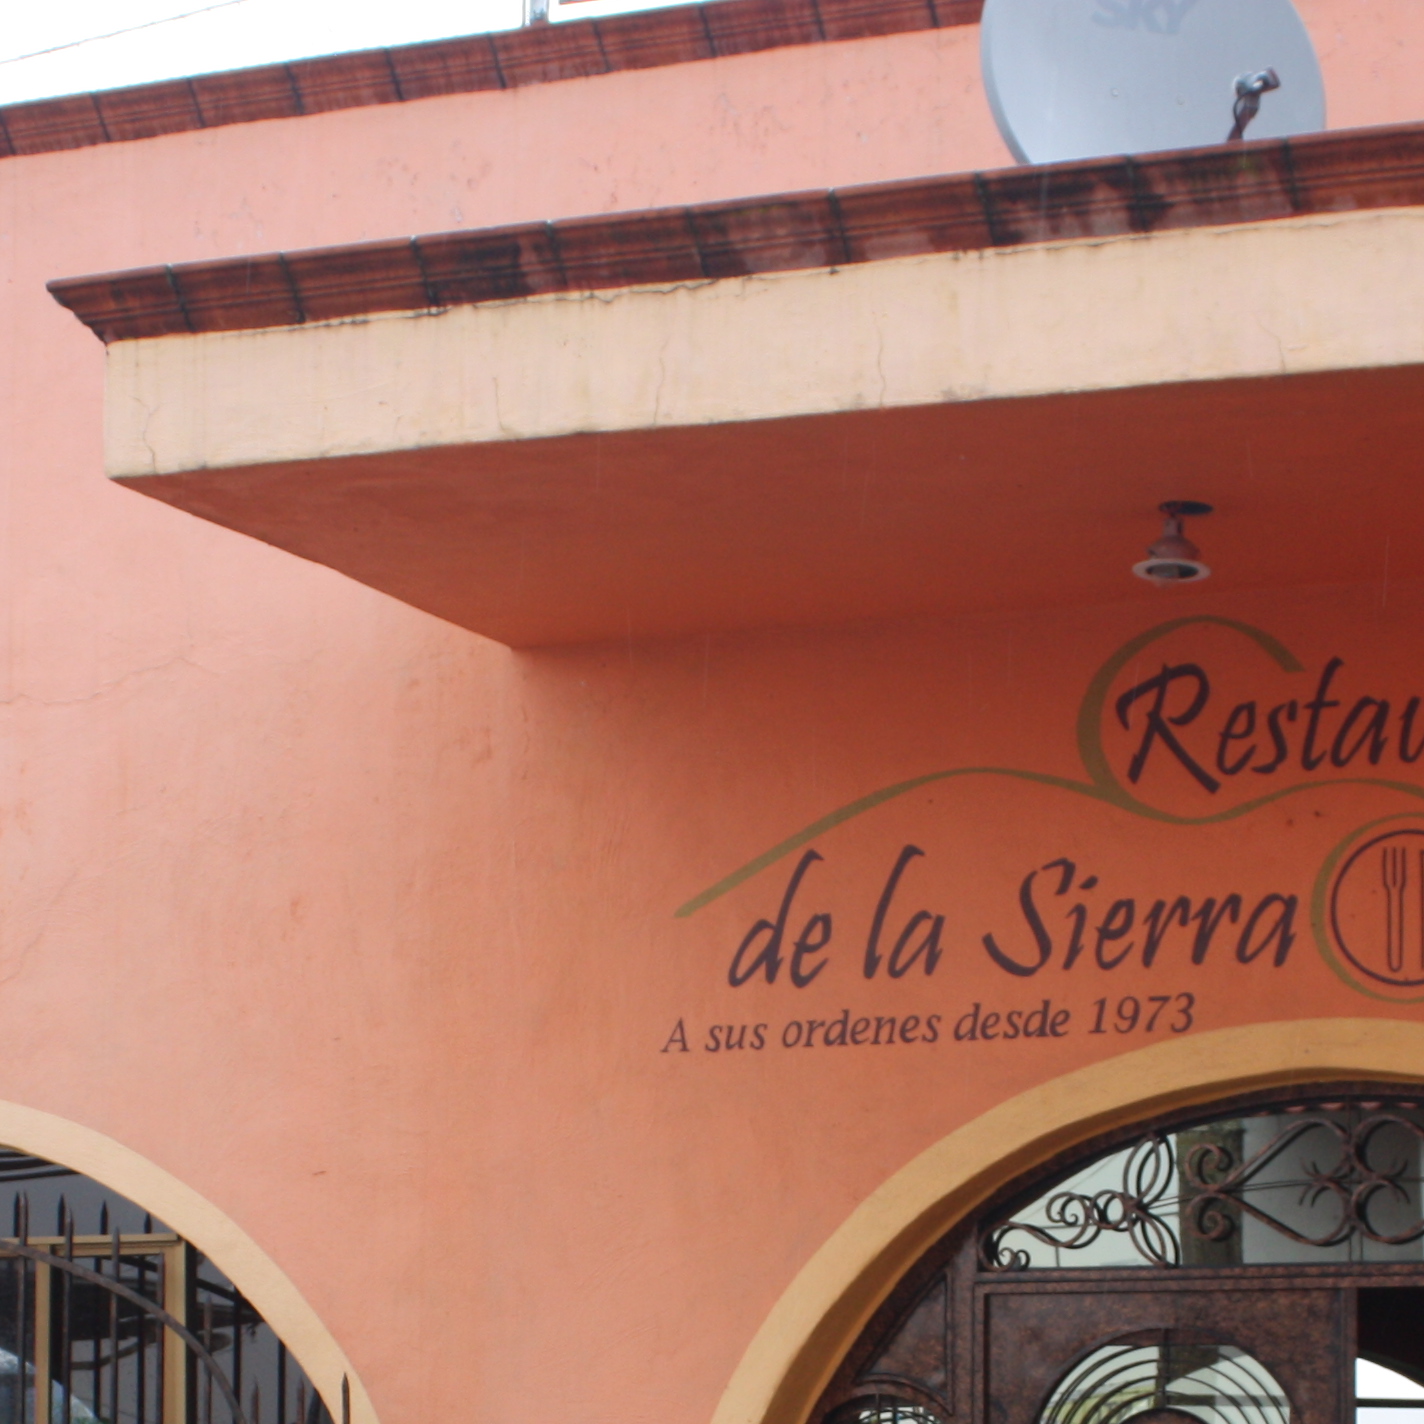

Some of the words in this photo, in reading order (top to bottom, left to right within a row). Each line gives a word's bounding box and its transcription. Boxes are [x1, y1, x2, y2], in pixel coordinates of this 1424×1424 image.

[727, 848, 833, 988] de
[862, 844, 946, 980] la
[981, 857, 1300, 978] Sierra
[660, 1017, 692, 1053] A
[704, 1018, 768, 1052] sus
[781, 1009, 942, 1049] ordenes
[952, 1000, 1071, 1042] desde
[1087, 991, 1196, 1035] 1973
